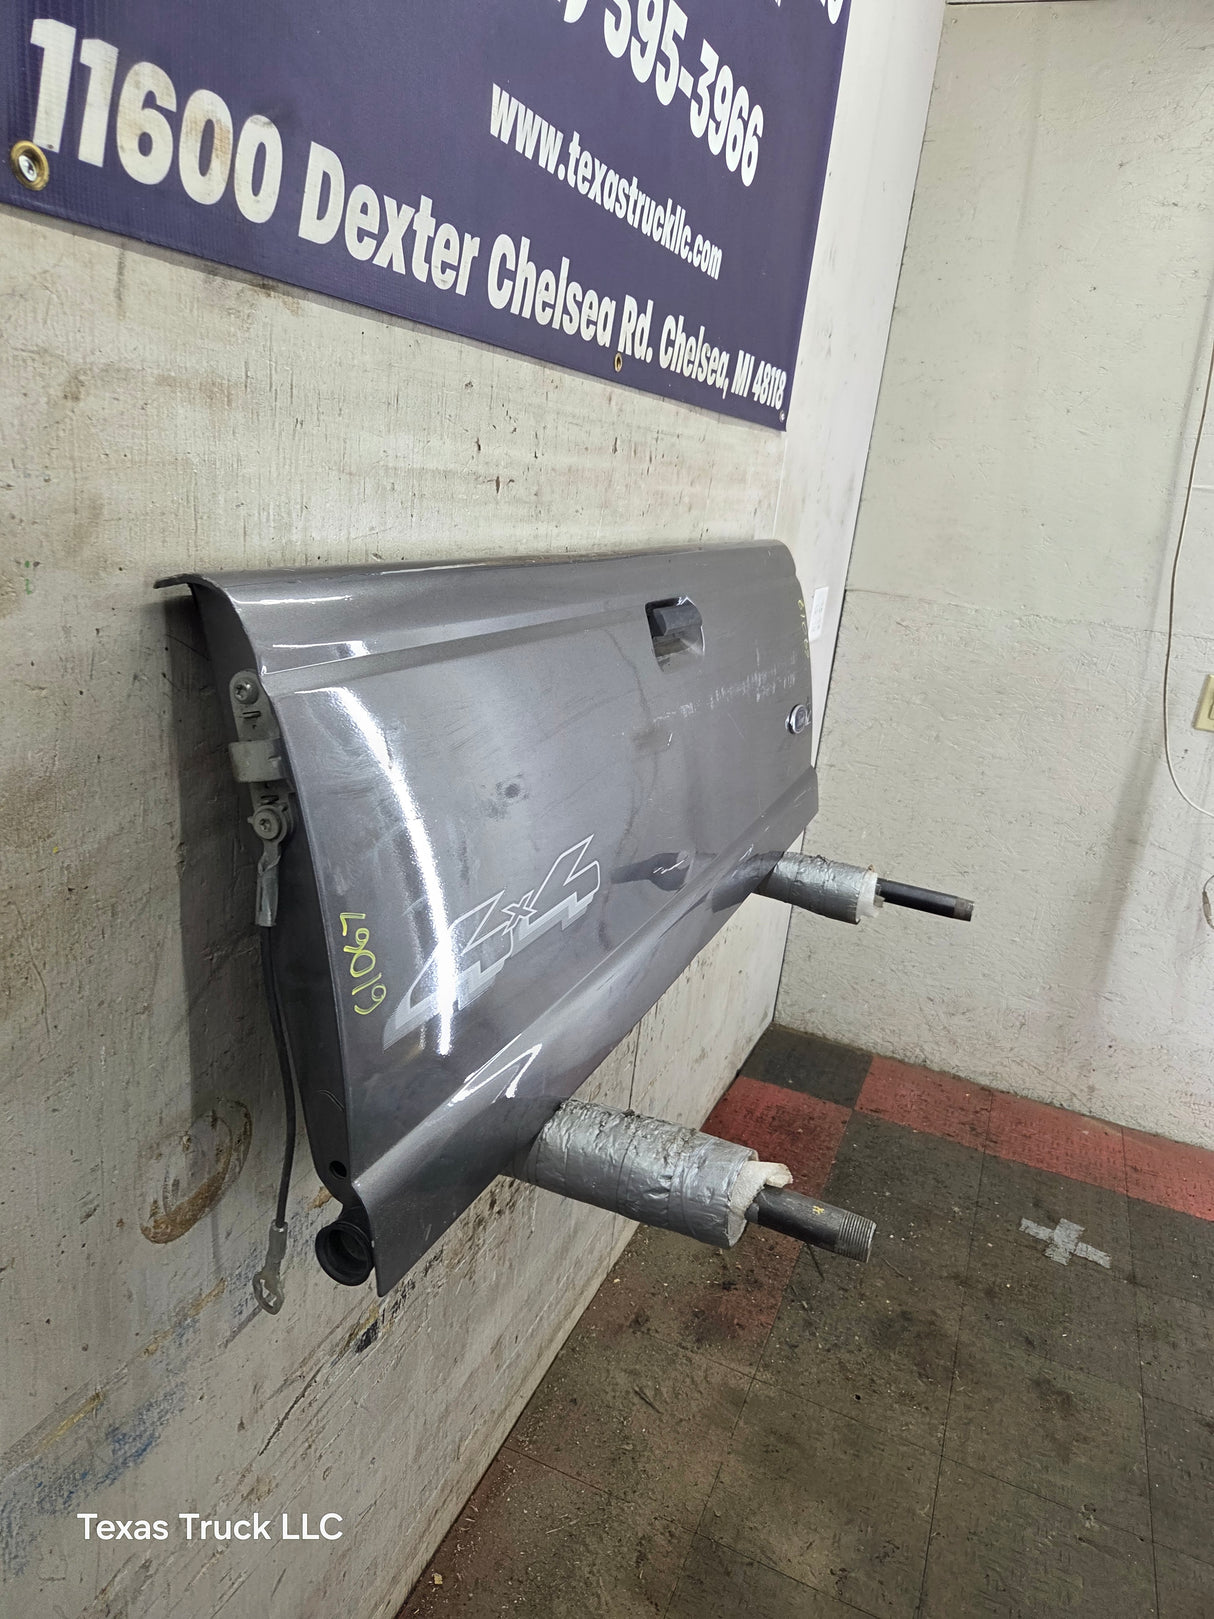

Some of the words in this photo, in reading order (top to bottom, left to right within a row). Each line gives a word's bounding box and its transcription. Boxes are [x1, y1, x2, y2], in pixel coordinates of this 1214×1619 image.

[30, 18, 283, 224] 11600
[298, 141, 480, 296] Dexter
[487, 233, 616, 348] Chelsea
[617, 294, 654, 363] Rd.
[659, 314, 730, 399] Chelsea,
[731, 350, 755, 397] MI
[752, 360, 787, 410] 48118
[489, 82, 723, 280] www.texastruckllc.com
